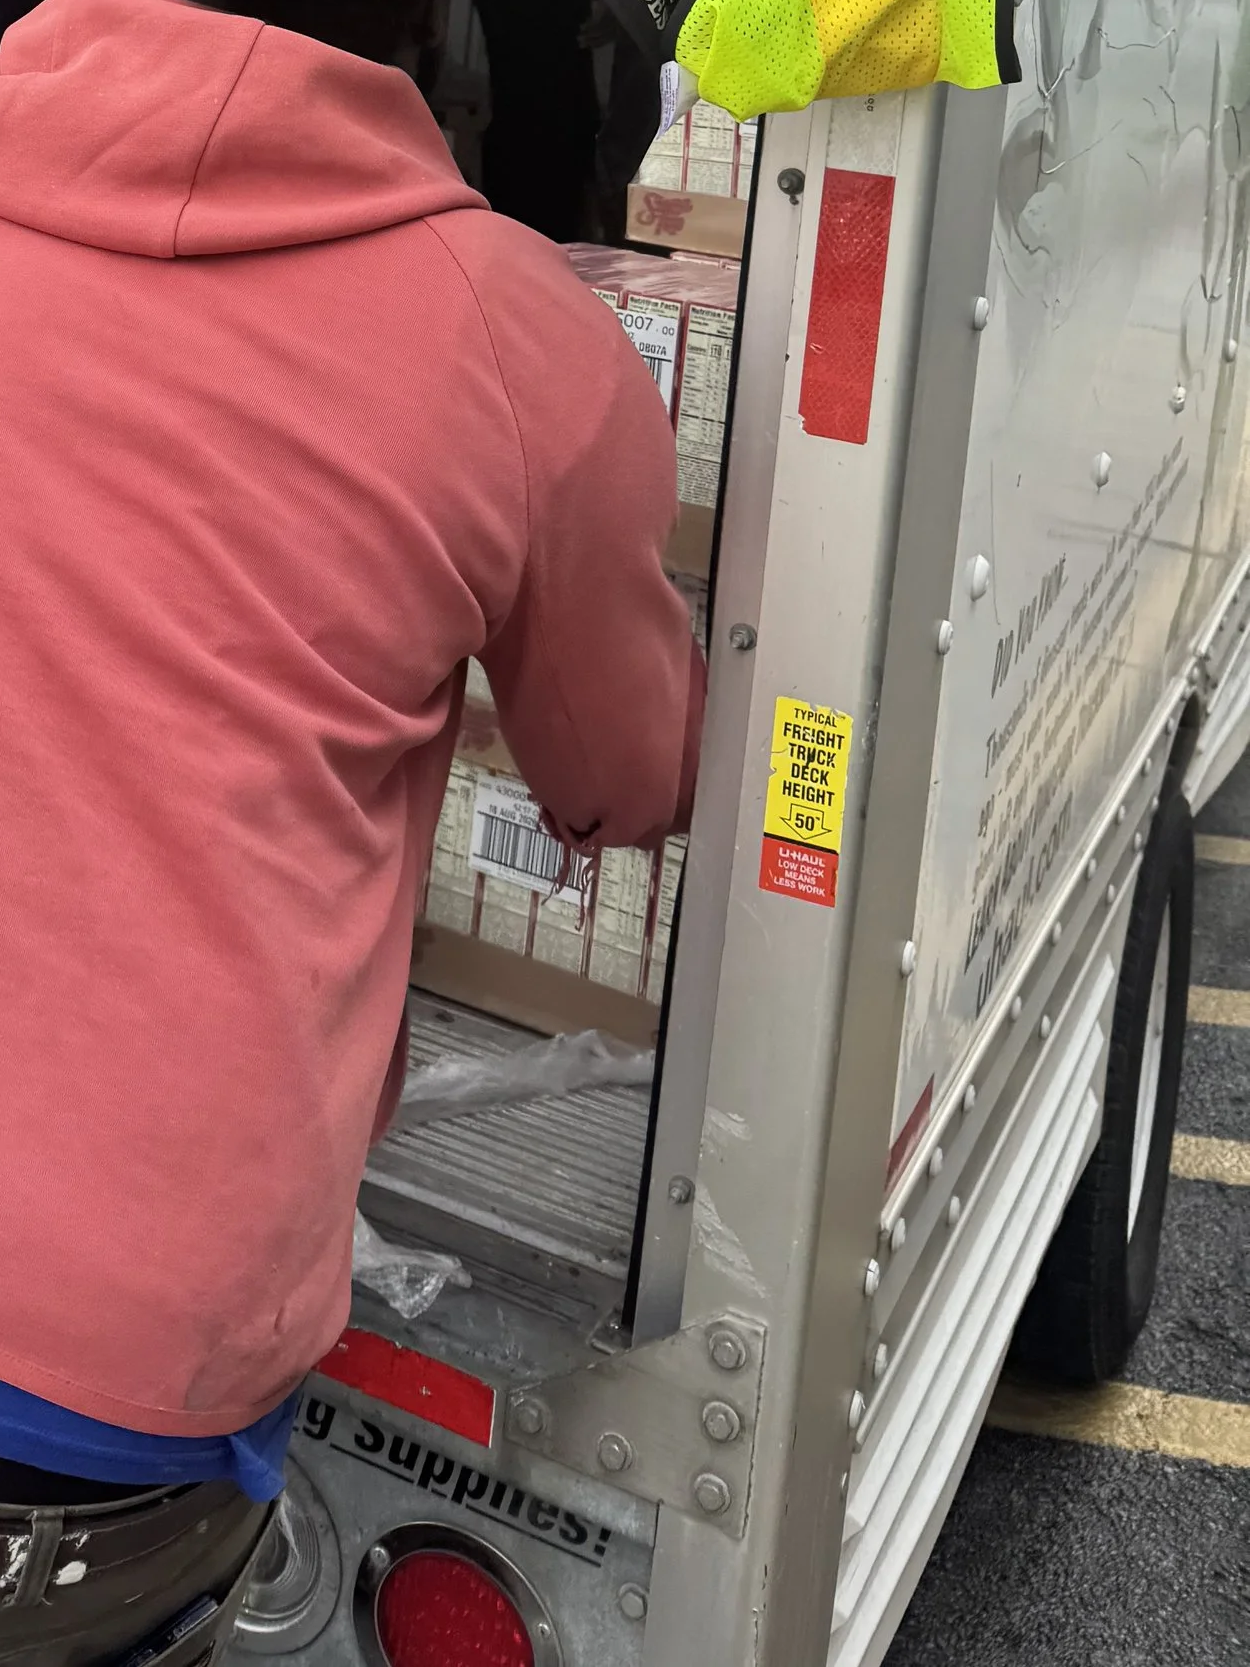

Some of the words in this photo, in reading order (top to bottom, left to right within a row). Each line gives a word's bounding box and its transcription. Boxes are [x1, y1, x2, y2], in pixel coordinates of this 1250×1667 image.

[660, 301, 679, 311] Facts
[691, 307, 721, 319] Nutrition
[794, 707, 837, 729] TYPICAL
[783, 722, 845, 751] FREIGHT
[789, 742, 837, 768] TRUCK
[790, 762, 829, 787] DECK
[782, 780, 835, 808] HEIGHT
[500, 807, 516, 821] AUG
[778, 858, 798, 871] LOW
[798, 864, 825, 878] DECK
[779, 846, 826, 868] U-HAUL
[773, 876, 796, 891] LESS
[797, 882, 826, 898] WORK
[784, 870, 816, 885] MEANS
